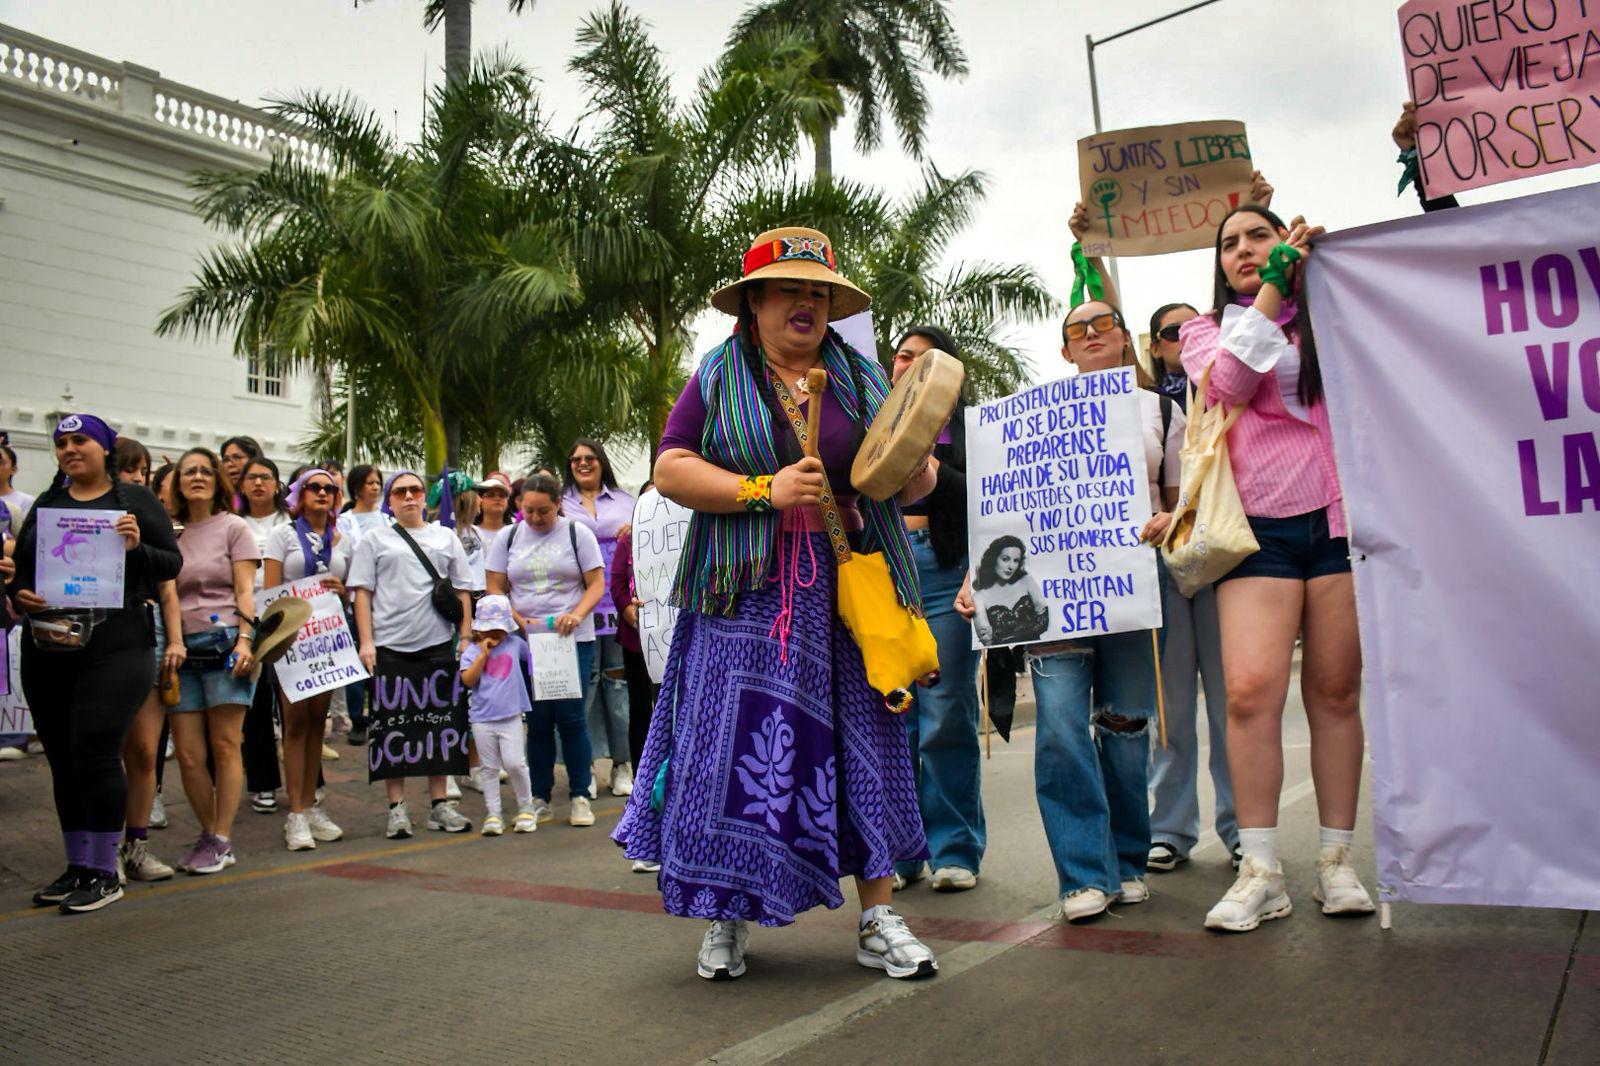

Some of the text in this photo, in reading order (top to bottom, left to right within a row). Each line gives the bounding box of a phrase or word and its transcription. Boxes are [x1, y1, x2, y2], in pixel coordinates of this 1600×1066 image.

[1402, 0, 1557, 57] QUIERO
[1410, 30, 1600, 109] DE VIEJA
[1088, 139, 1167, 173] JUNTAS
[1416, 98, 1596, 186] POR SER
[1131, 173, 1200, 205] Y SIN
[979, 386, 1051, 427] PROTESTEN,
[1002, 400, 1106, 444] NO SE DEJEN
[981, 467, 1032, 497] HAGAN
[1036, 463, 1054, 488] DE
[1058, 458, 1080, 481] SU
[981, 478, 1135, 516] LO QUE USTEDES DESEAN
[1025, 500, 1130, 533] Y NO LO QUE
[1030, 526, 1141, 556] SUS HOMBRES
[1068, 552, 1096, 573] LES
[64, 583, 81, 596] NO
[1043, 573, 1134, 601] PERMITAN
[1061, 600, 1109, 634] SER
[296, 665, 359, 692] COLECTIVA
